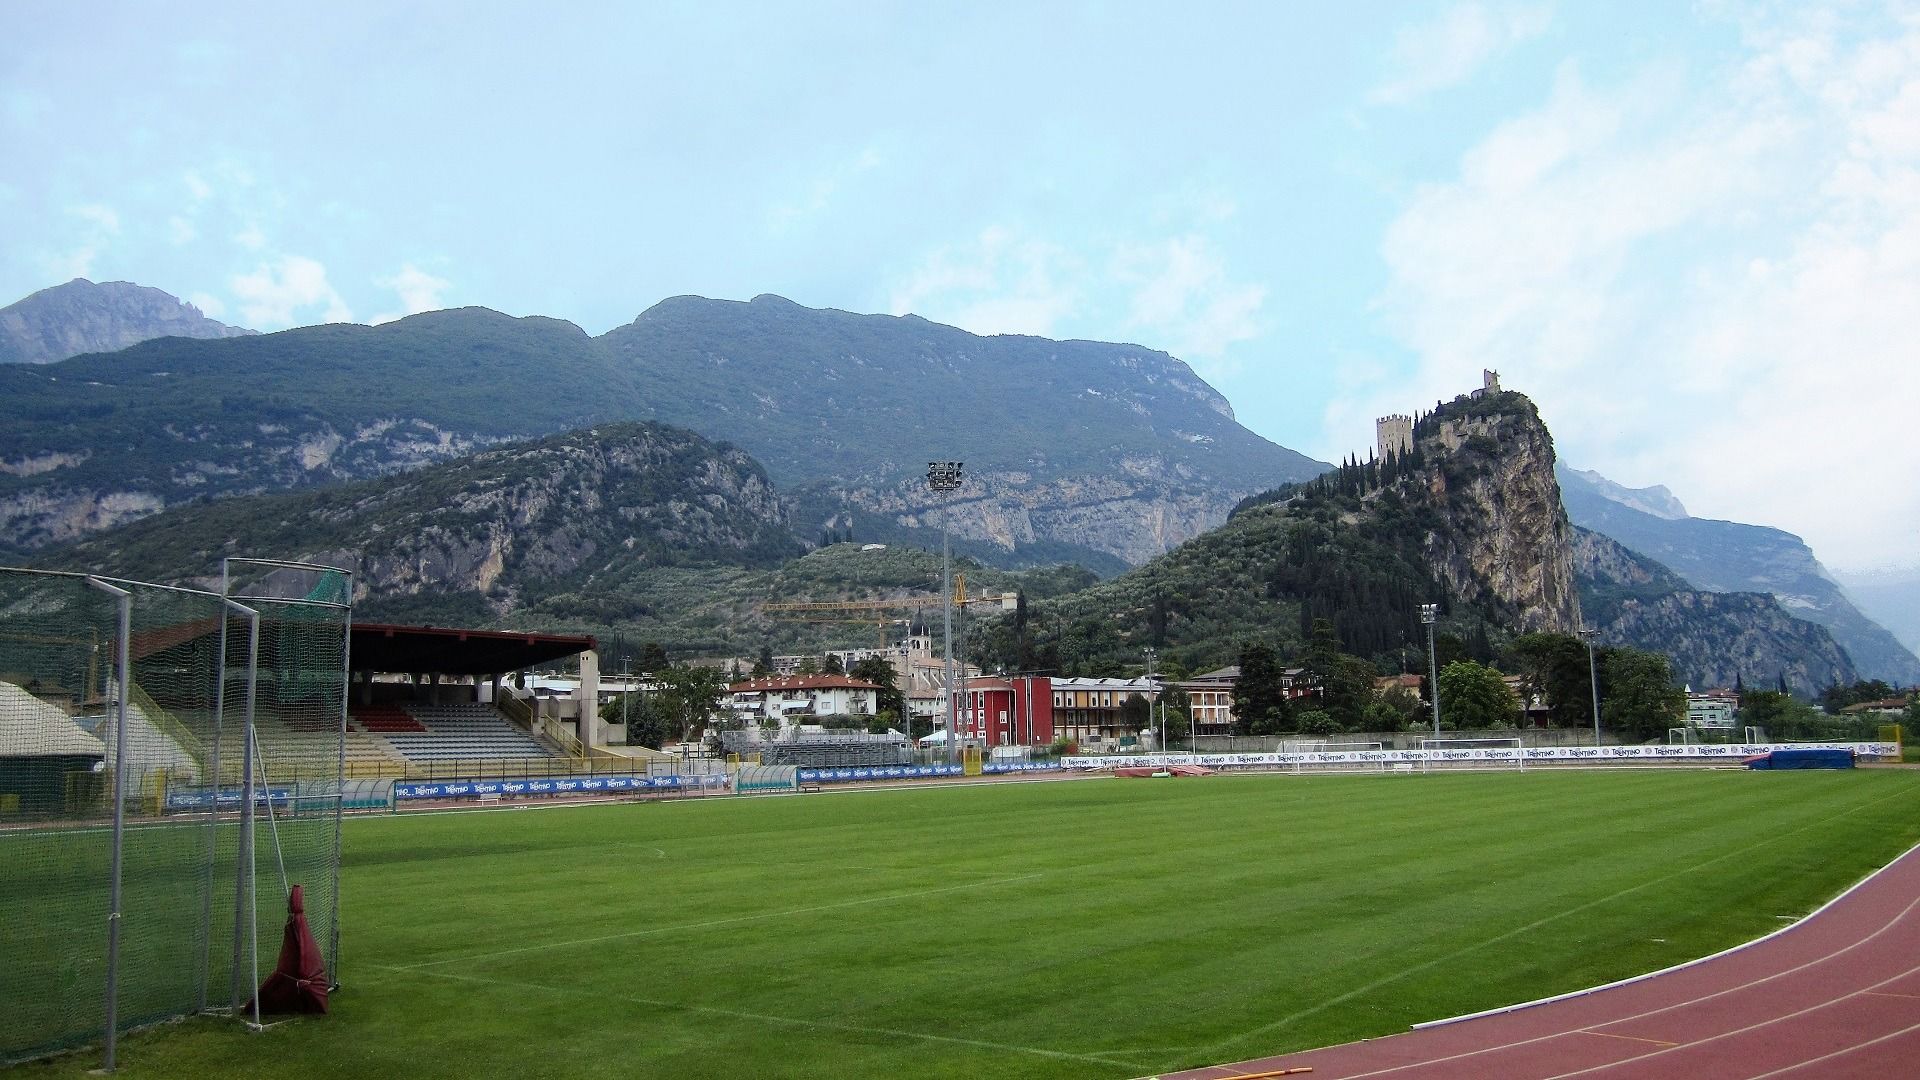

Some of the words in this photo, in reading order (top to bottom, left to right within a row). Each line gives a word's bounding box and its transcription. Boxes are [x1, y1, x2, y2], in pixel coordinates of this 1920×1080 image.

[1484, 749, 1512, 759] TRENTINO
[1526, 748, 1555, 758] TRENTINO
[1569, 747, 1598, 757] TRENTINO
[1612, 746, 1641, 757] TRENTINO
[1654, 745, 1683, 756] TRENTINO
[1697, 745, 1726, 755] TRENTINO
[1740, 744, 1770, 754] TRENTINO
[1237, 754, 1264, 764] TRENTINO
[1318, 752, 1345, 762] TRENTINO
[1442, 749, 1470, 760] TRENTINO
